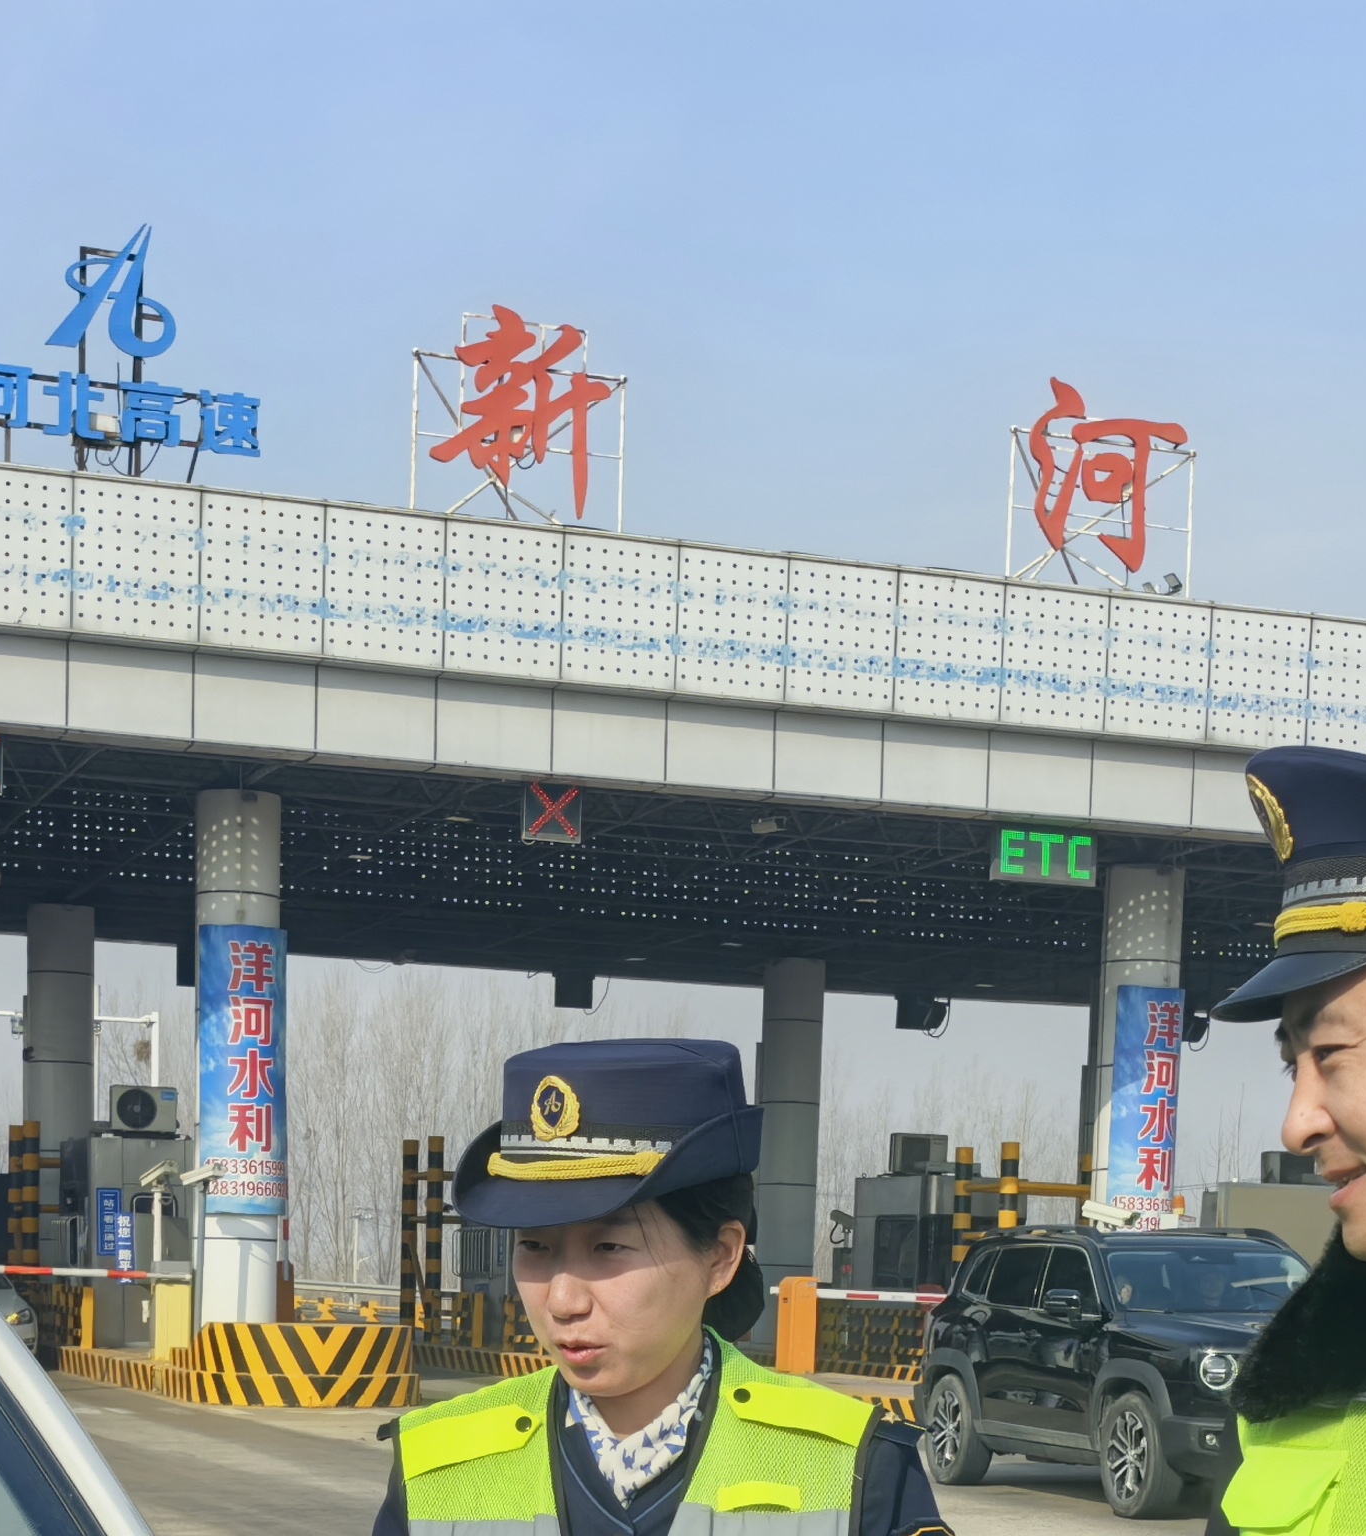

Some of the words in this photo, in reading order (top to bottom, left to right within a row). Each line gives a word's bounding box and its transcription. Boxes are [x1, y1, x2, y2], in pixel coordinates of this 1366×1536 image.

[429, 304, 611, 520] 新
[1029, 376, 1188, 574] 河
[999, 829, 1092, 880] ETC
[227, 940, 275, 1153] 洋河水利
[1136, 1000, 1182, 1192] 洋河水利
